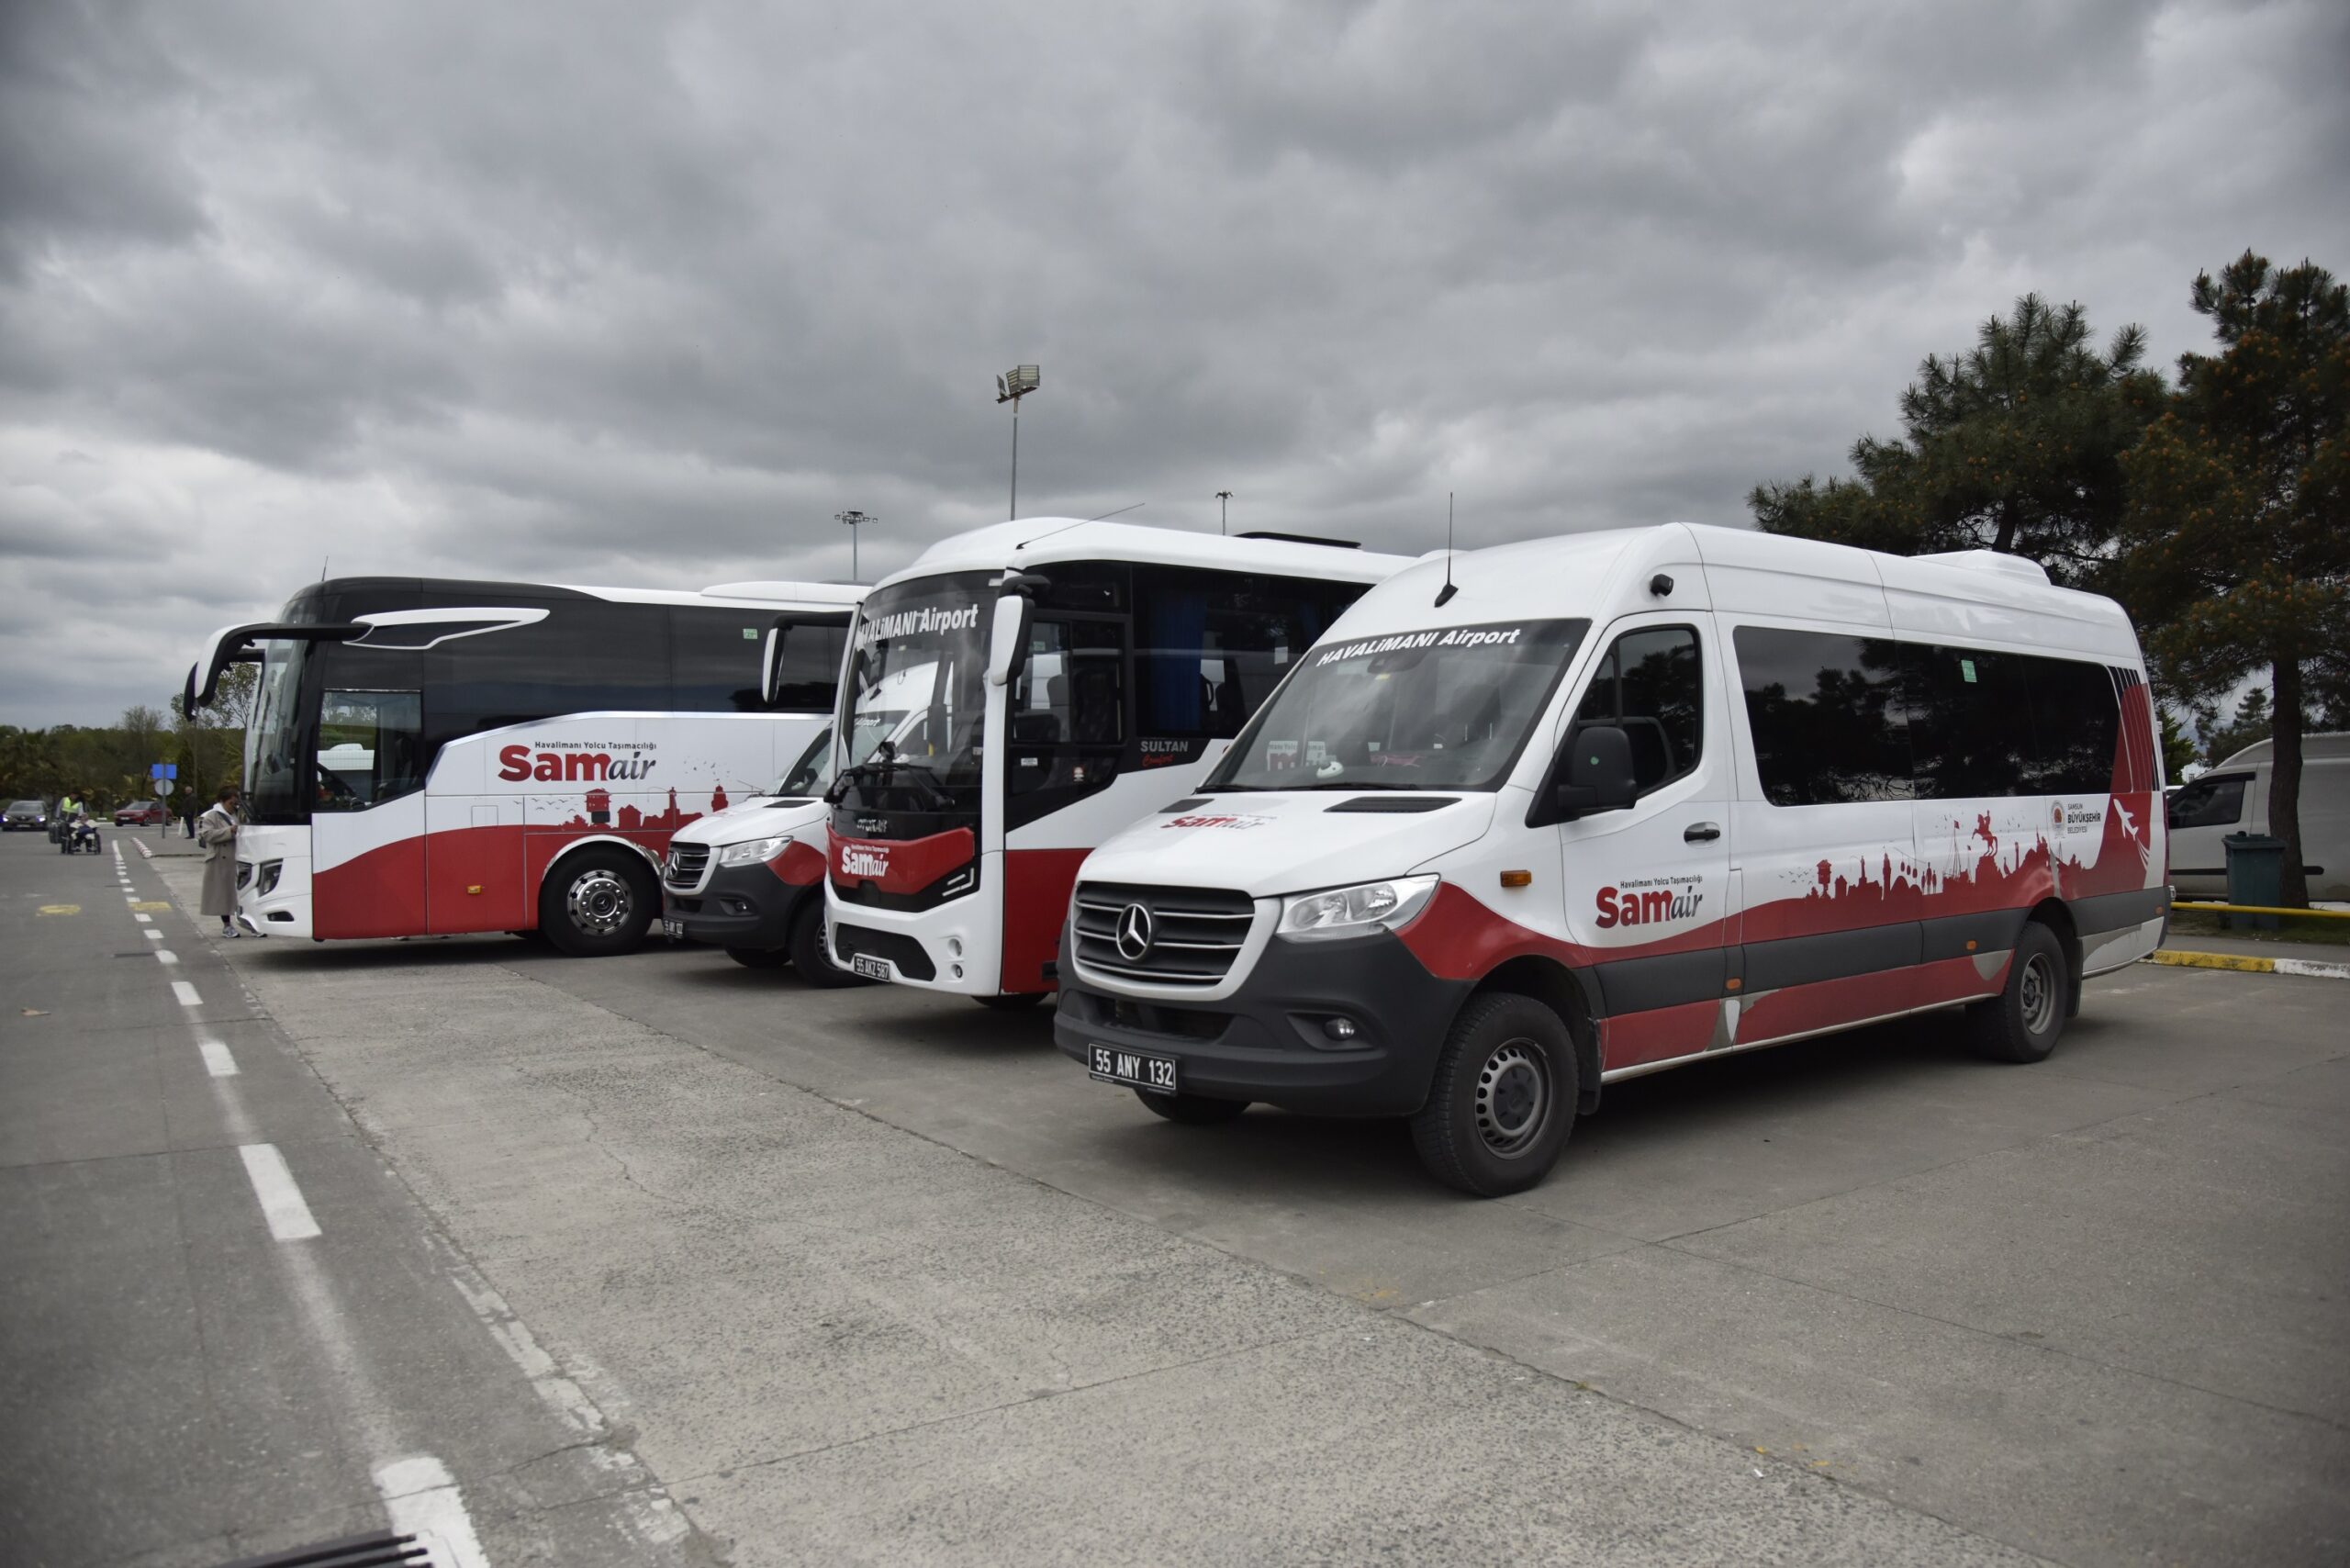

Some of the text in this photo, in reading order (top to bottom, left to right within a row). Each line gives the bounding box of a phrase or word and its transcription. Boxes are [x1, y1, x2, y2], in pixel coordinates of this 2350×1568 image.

[918, 603, 979, 636] Airport
[1438, 628, 1520, 648] Airport
[1140, 740, 1189, 753] SULTAN
[498, 745, 656, 782] Samair
[841, 846, 890, 877] Samair
[1653, 878, 1670, 886] Yolcu
[1595, 885, 1703, 929] Samair
[856, 958, 865, 973] 55
[1095, 1048, 1173, 1087] 55 ANY 132
